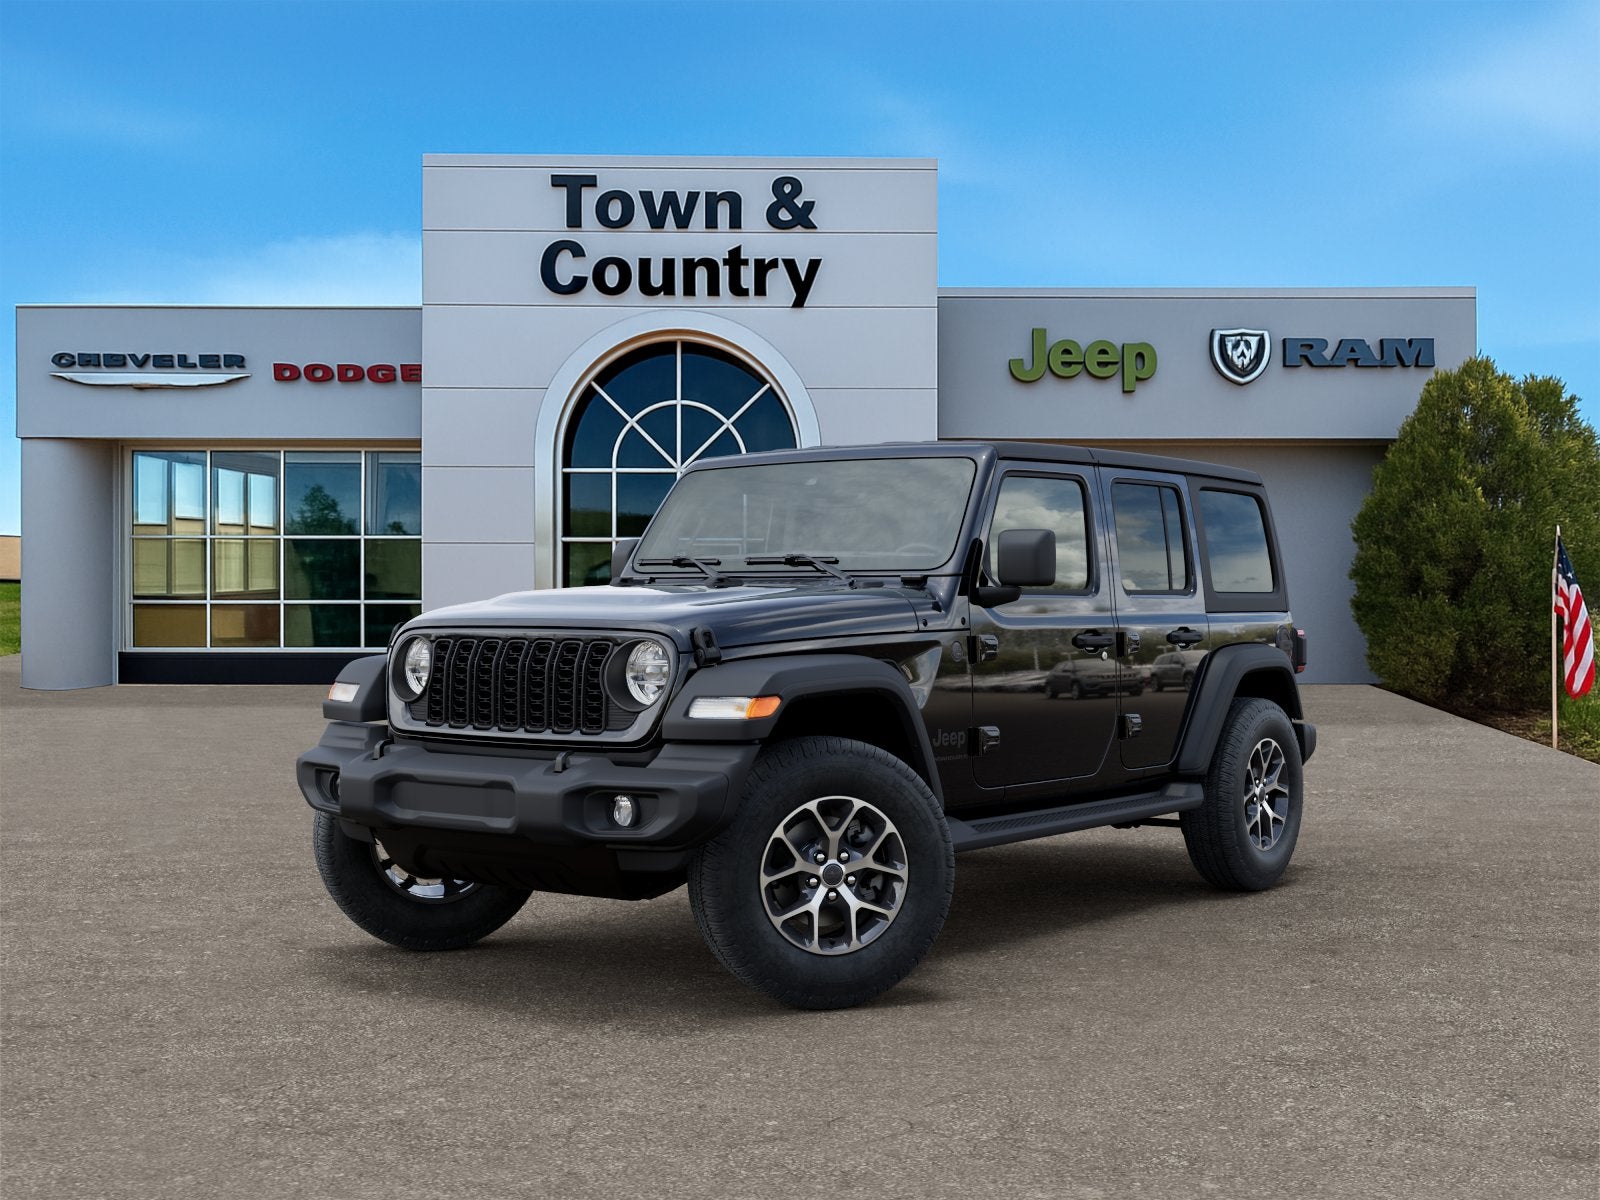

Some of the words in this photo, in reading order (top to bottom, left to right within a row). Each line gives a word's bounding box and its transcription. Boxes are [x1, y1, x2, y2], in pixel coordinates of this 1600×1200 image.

[550, 174, 743, 230] Town
[765, 175, 818, 230] &
[540, 239, 822, 308] Country
[273, 362, 422, 383] DODGE
[1009, 328, 1157, 392] Jeep
[1282, 337, 1435, 368] RAM
[932, 728, 966, 749] Jeep
